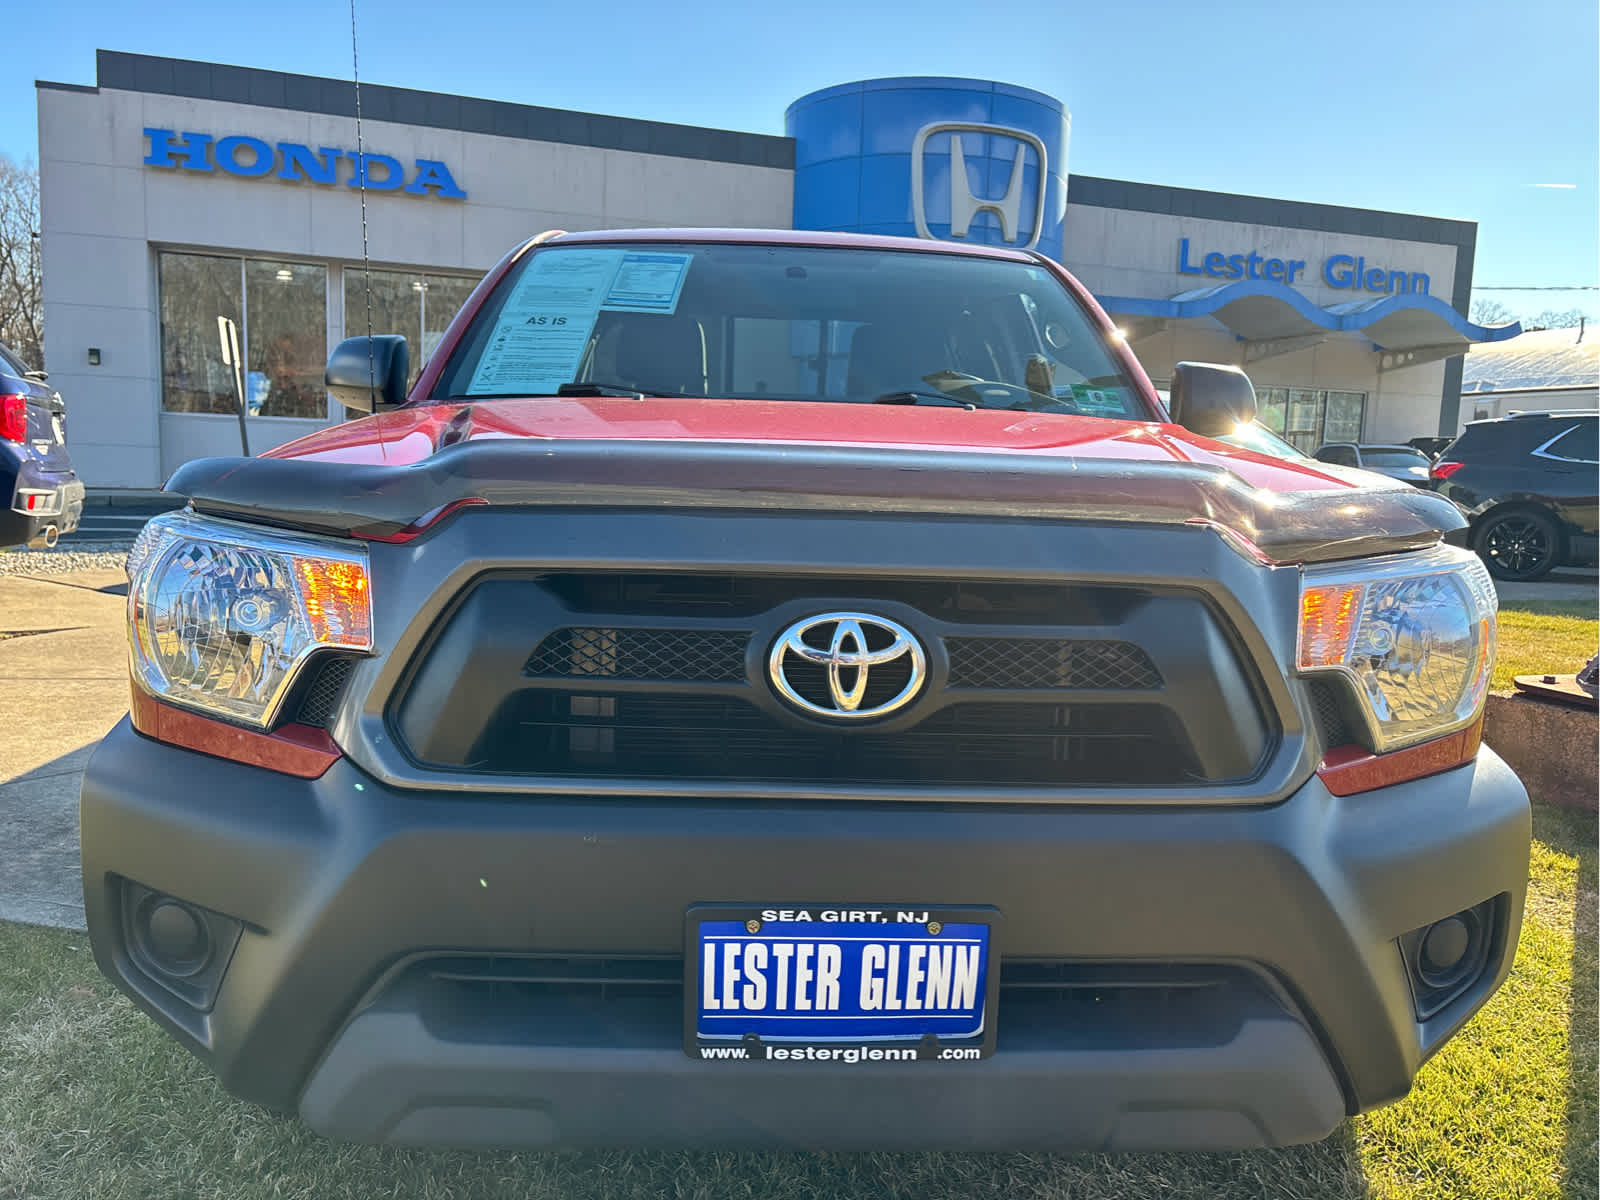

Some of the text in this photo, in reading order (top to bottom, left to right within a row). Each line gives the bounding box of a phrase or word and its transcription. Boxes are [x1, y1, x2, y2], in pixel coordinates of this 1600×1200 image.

[143, 127, 468, 199] HONDA
[1178, 238, 1431, 296] Lester Glenn
[526, 316, 567, 325] AS IS
[761, 910, 929, 924] SEA GIRT, NJ
[703, 943, 981, 1010] LESTER GLENN
[701, 1046, 981, 1063] www. lesterglenn .com
